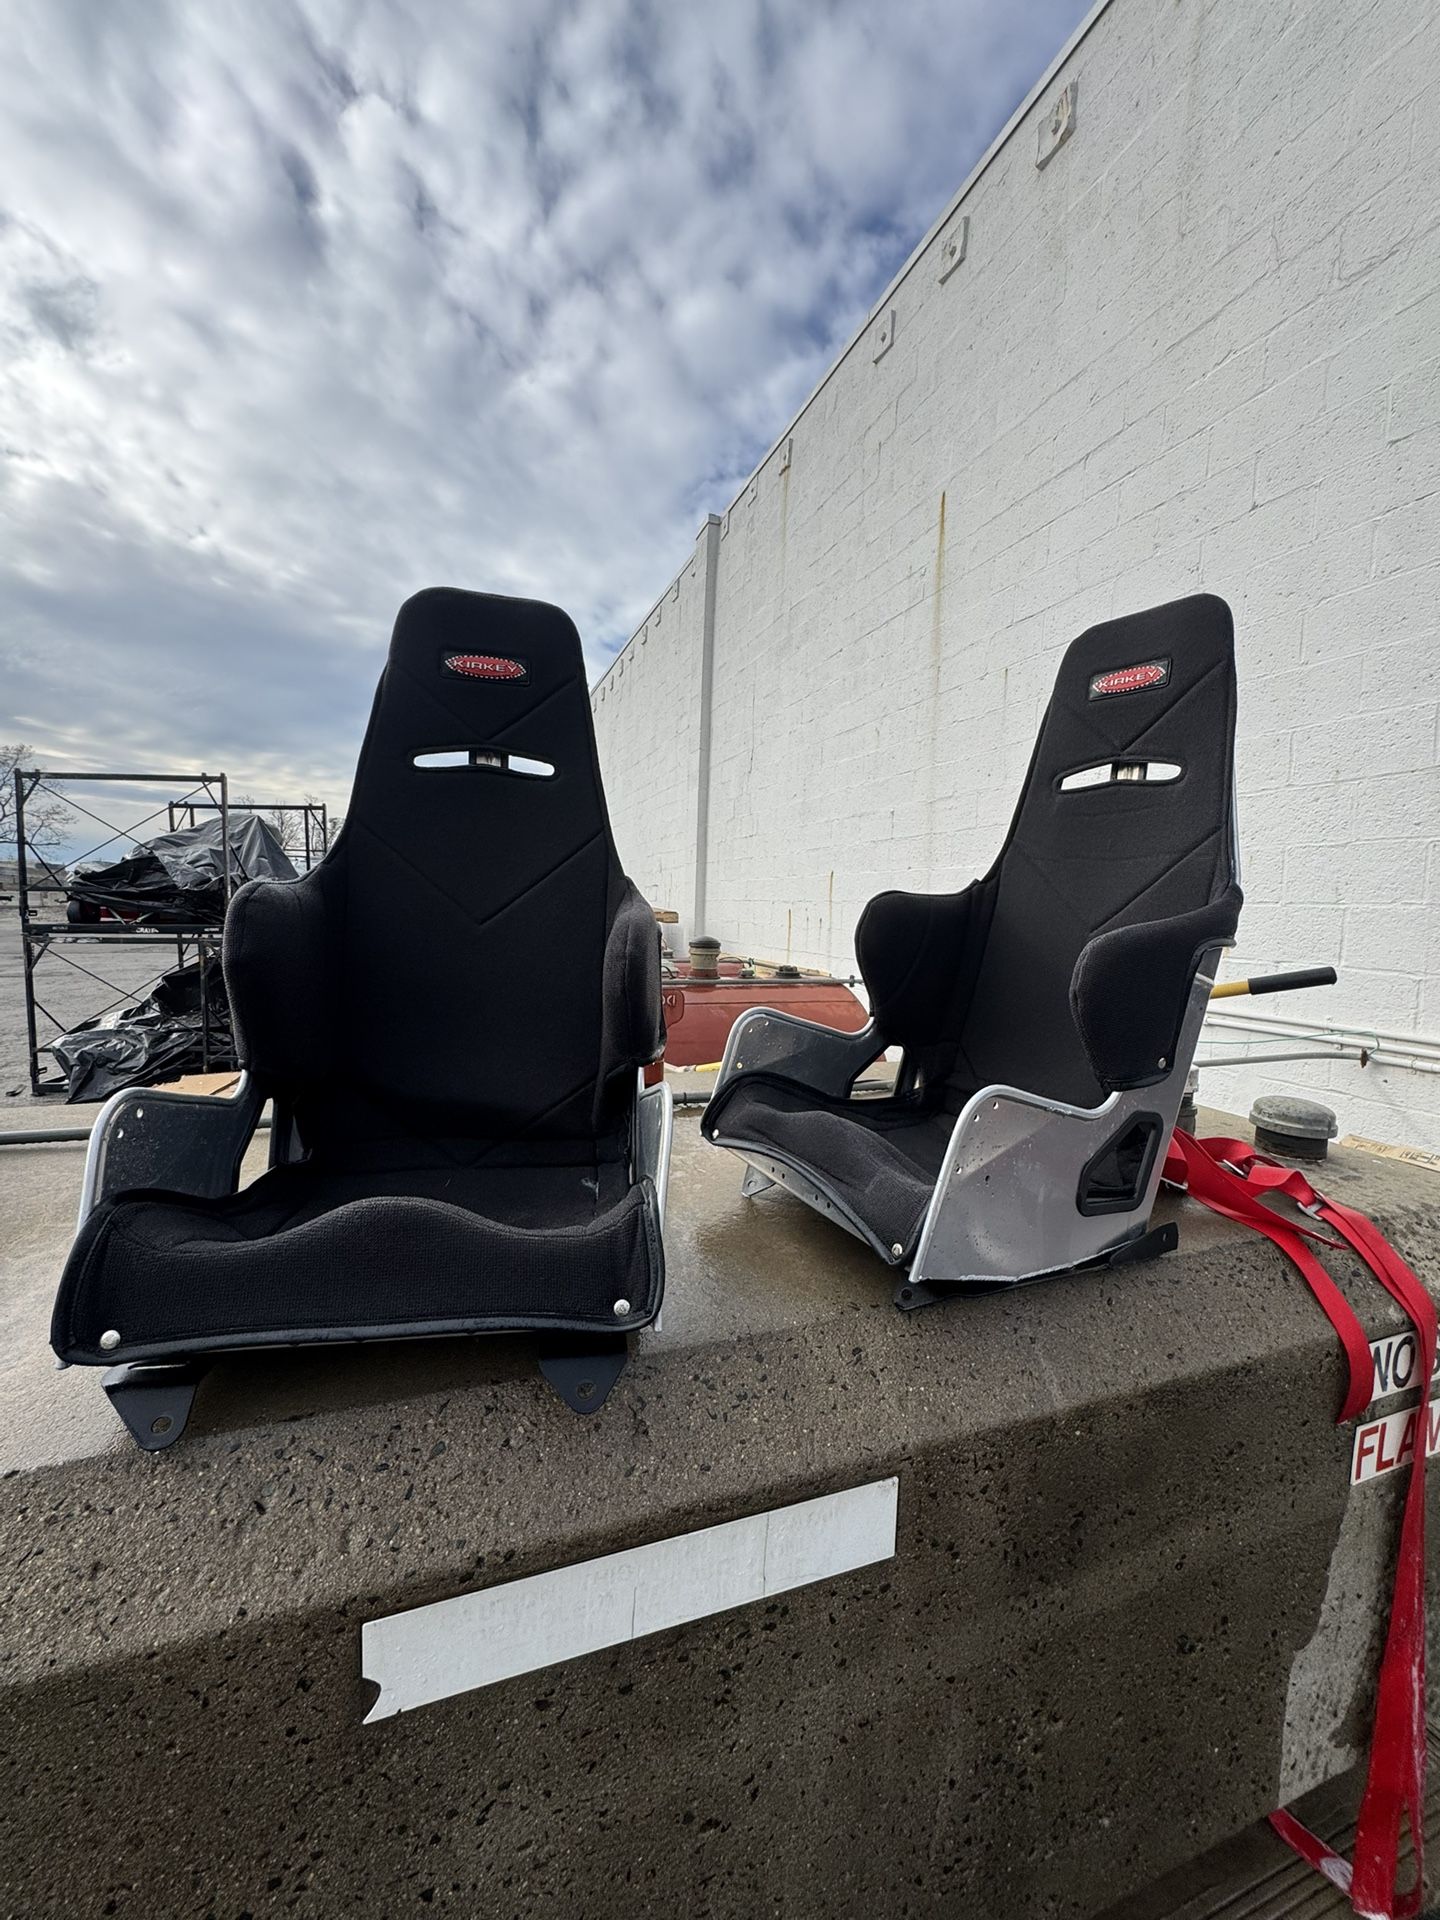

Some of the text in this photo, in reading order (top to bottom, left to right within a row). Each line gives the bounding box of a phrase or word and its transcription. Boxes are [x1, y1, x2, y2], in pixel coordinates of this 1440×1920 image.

[453, 660, 517, 673] KIRKEY
[1098, 670, 1157, 688] KIRKEY
[1373, 1335, 1416, 1392] NO
